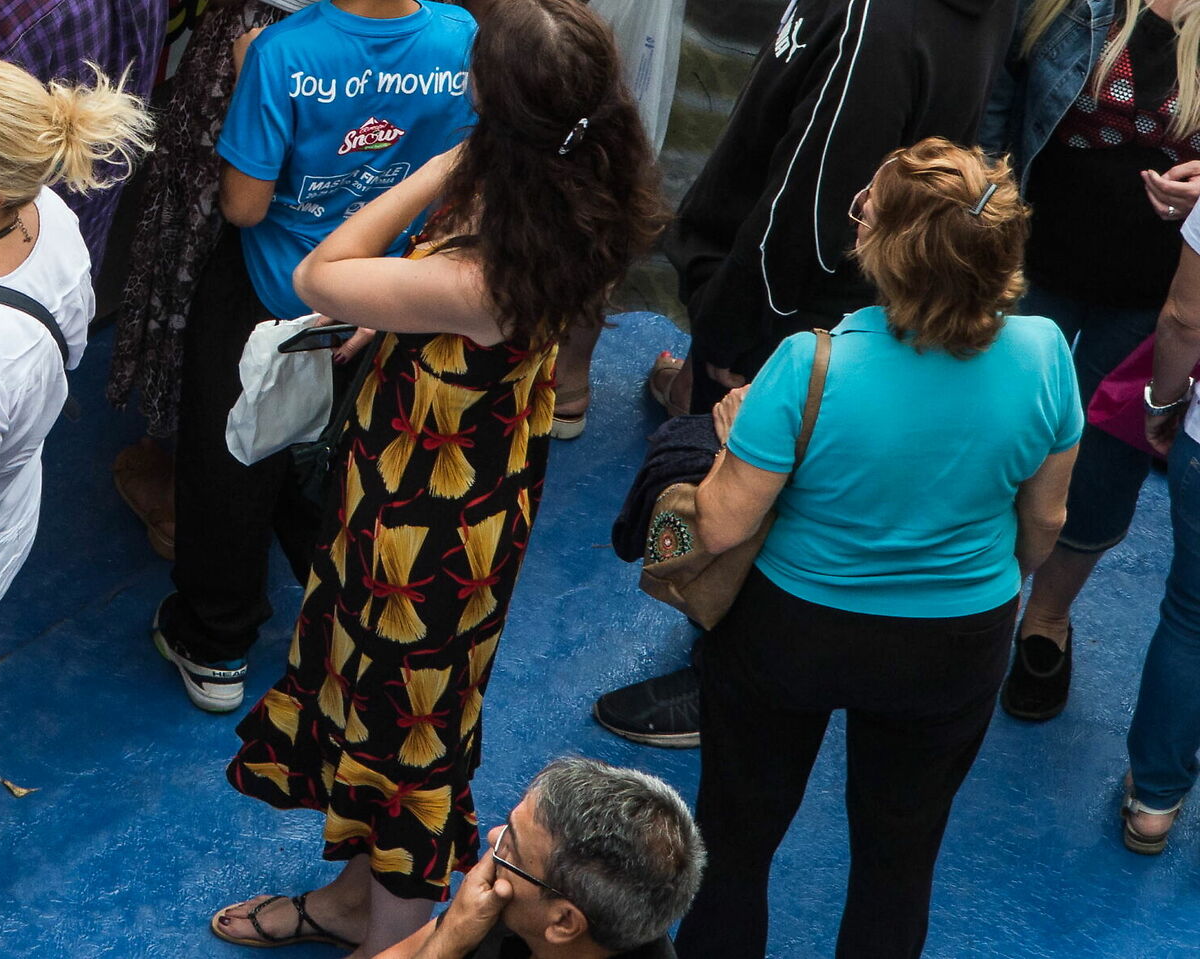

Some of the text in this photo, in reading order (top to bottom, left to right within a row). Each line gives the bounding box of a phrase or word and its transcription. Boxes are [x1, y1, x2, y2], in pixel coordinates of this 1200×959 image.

[288, 67, 470, 104] Joy of moving
[337, 128, 406, 155] Snow
